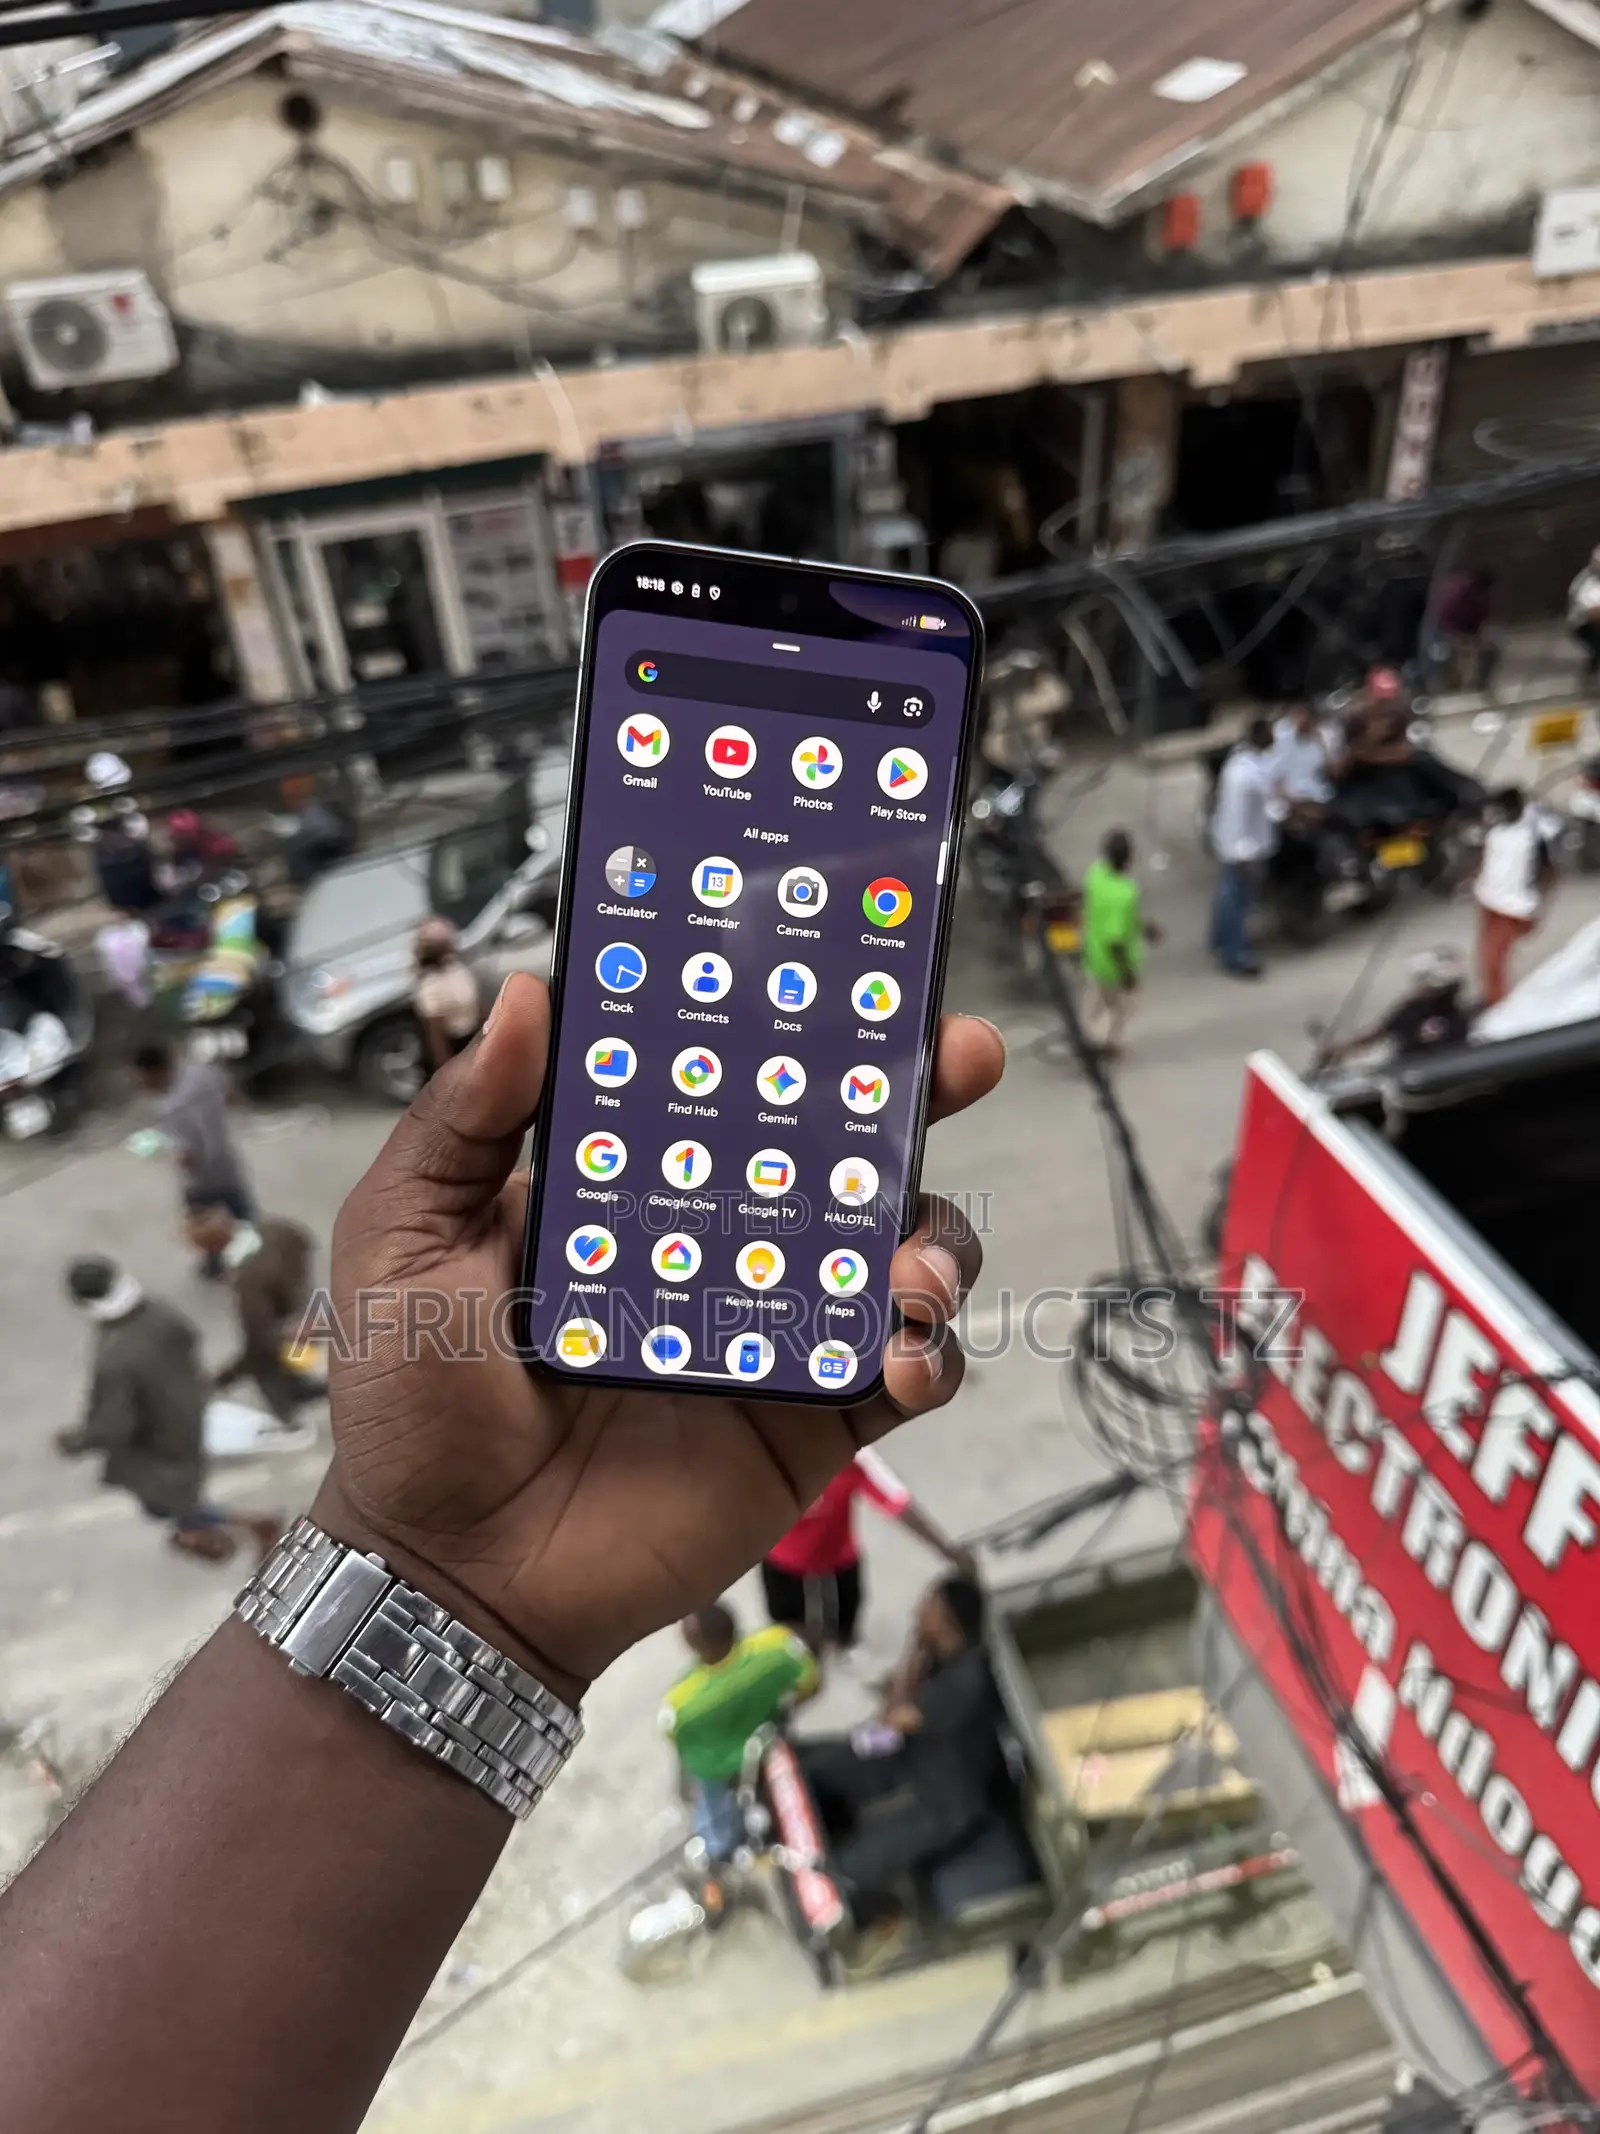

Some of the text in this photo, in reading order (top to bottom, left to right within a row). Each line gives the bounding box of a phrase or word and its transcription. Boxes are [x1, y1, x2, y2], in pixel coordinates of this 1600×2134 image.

[636, 575, 666, 592] 18:18
[622, 773, 658, 789] Gmail
[702, 783, 752, 801] YouTube
[793, 795, 833, 811] Photos
[870, 805, 927, 823] Play Store
[743, 827, 790, 846] All apps
[711, 876, 724, 888] 13
[596, 902, 658, 920] Calculator
[687, 913, 741, 930] Calendar
[776, 923, 821, 939] Camera
[860, 933, 906, 949] Chrome
[600, 1000, 634, 1014] Clock
[677, 1008, 730, 1024] Contacts
[773, 1019, 802, 1032] Docs
[857, 1028, 887, 1042] Drive
[594, 1094, 621, 1108] Files
[667, 1102, 719, 1118] Find Hub
[757, 1111, 798, 1126] Gemini
[844, 1120, 878, 1134] Gmail
[576, 1187, 620, 1203] Google
[648, 1195, 718, 1212] Google One
[737, 1203, 797, 1219] Google TV
[824, 1211, 876, 1227] HALOTEL
[568, 1281, 607, 1295] Health
[655, 1288, 690, 1302] Home
[725, 1295, 788, 1311] Keep notes
[824, 1304, 856, 1319] Maps
[1238, 1252, 1600, 1816] ELECTRONI
